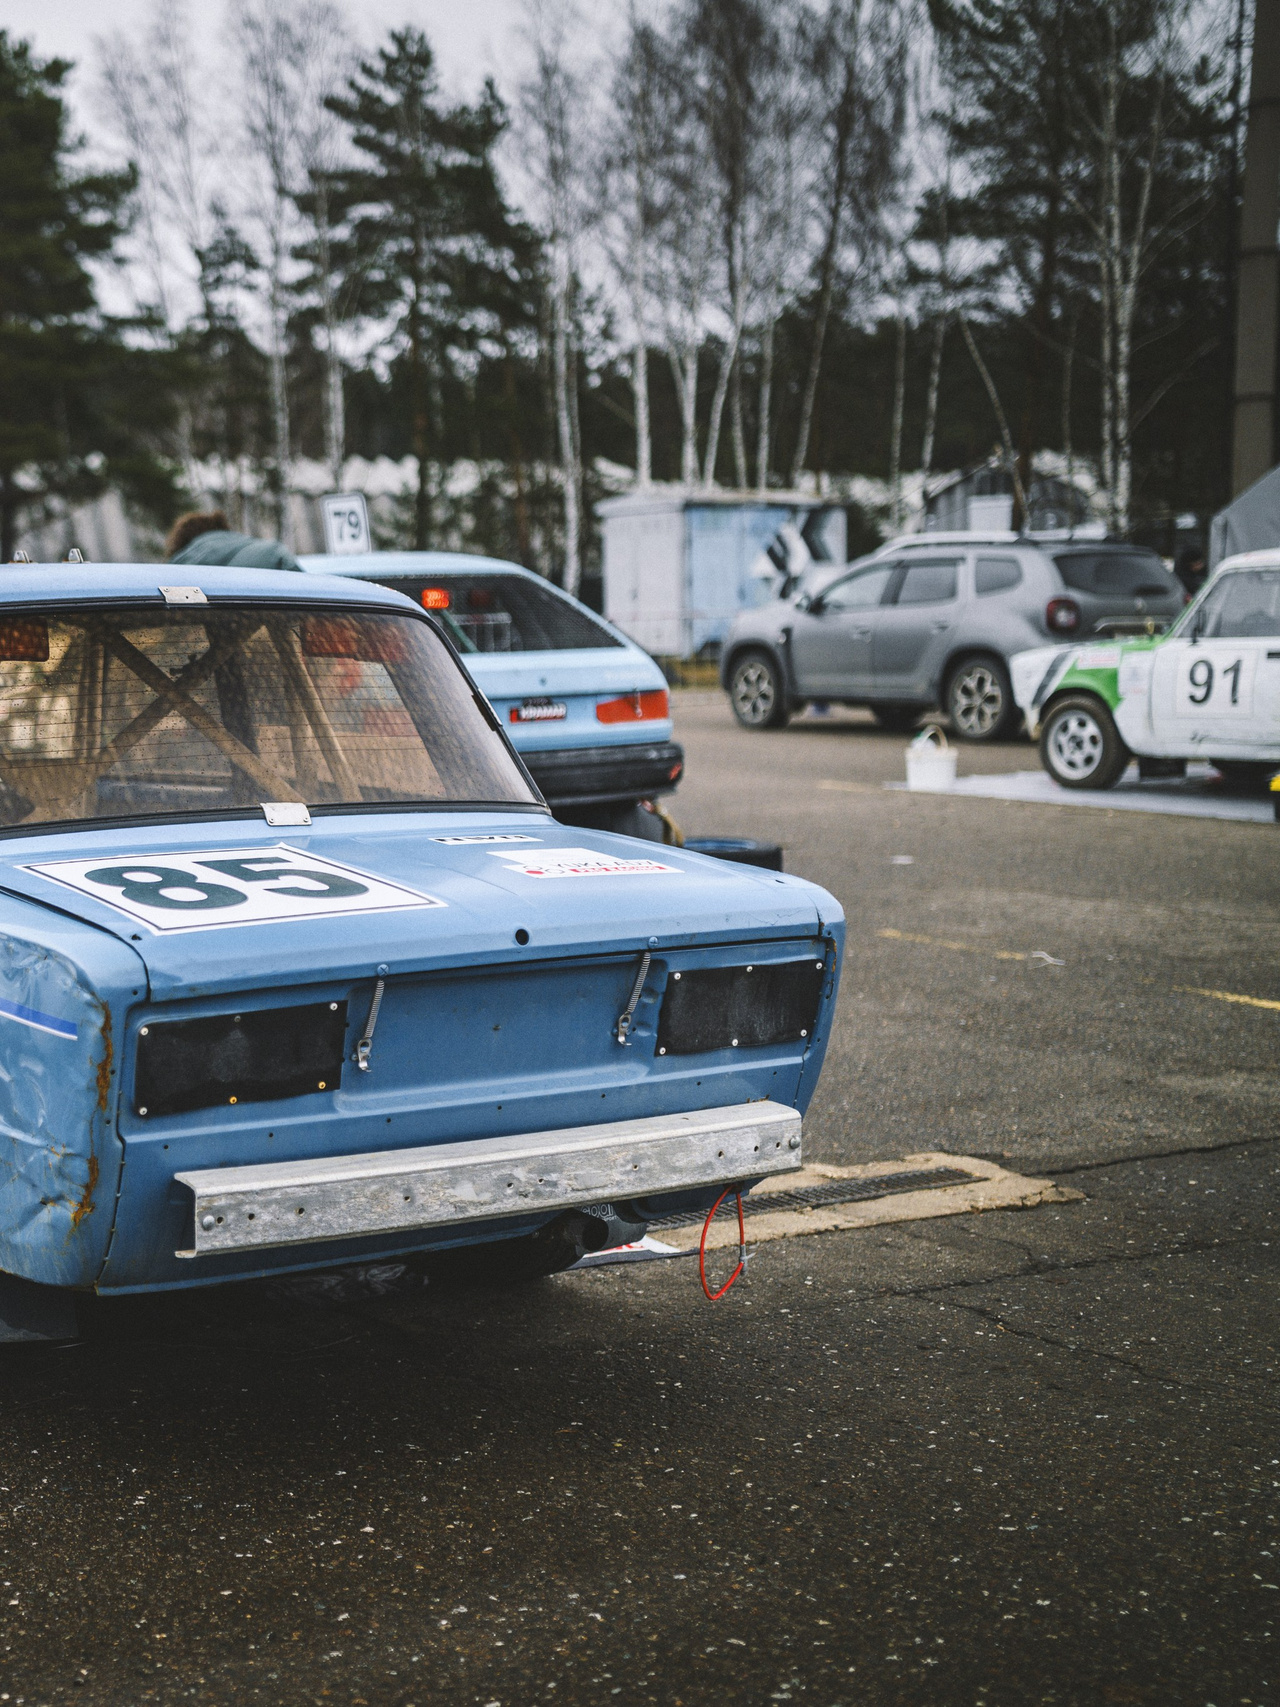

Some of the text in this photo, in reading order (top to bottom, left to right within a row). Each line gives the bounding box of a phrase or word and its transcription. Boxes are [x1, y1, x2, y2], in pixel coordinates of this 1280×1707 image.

[333, 510, 360, 540] 79
[1189, 659, 1242, 704] 91
[84, 856, 370, 911] 85
